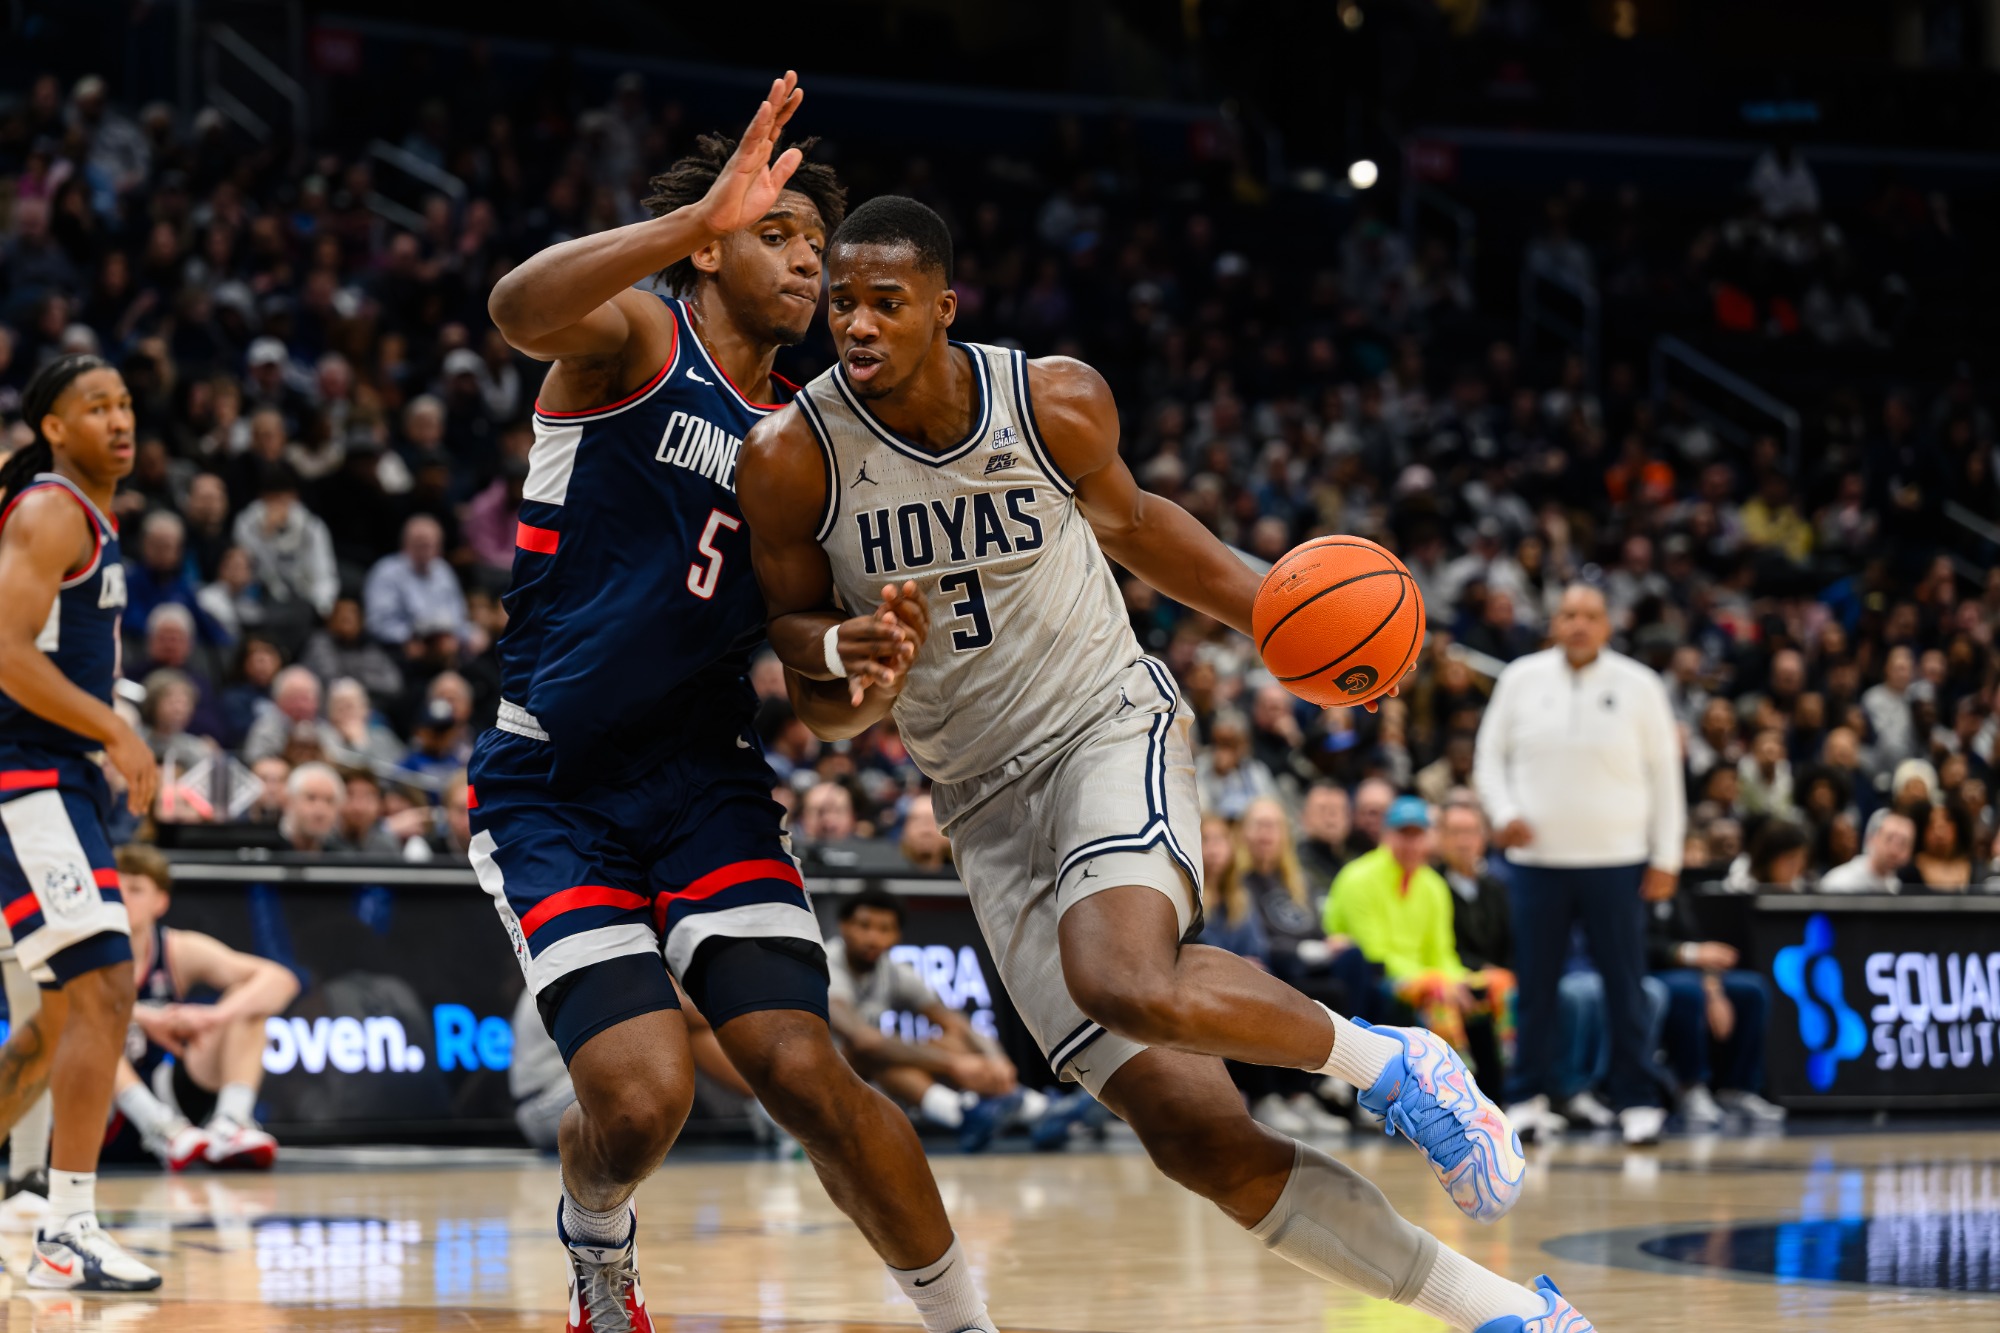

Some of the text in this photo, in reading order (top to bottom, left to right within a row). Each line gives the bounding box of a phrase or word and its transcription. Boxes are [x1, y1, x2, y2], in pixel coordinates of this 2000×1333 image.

[655, 411, 743, 494] CONNE
[984, 457, 1019, 474] EAST
[988, 452, 1013, 463] BIG
[993, 429, 1006, 440] BE
[686, 507, 742, 600] 5
[855, 487, 1044, 575] HOYAS
[938, 567, 996, 653] 3
